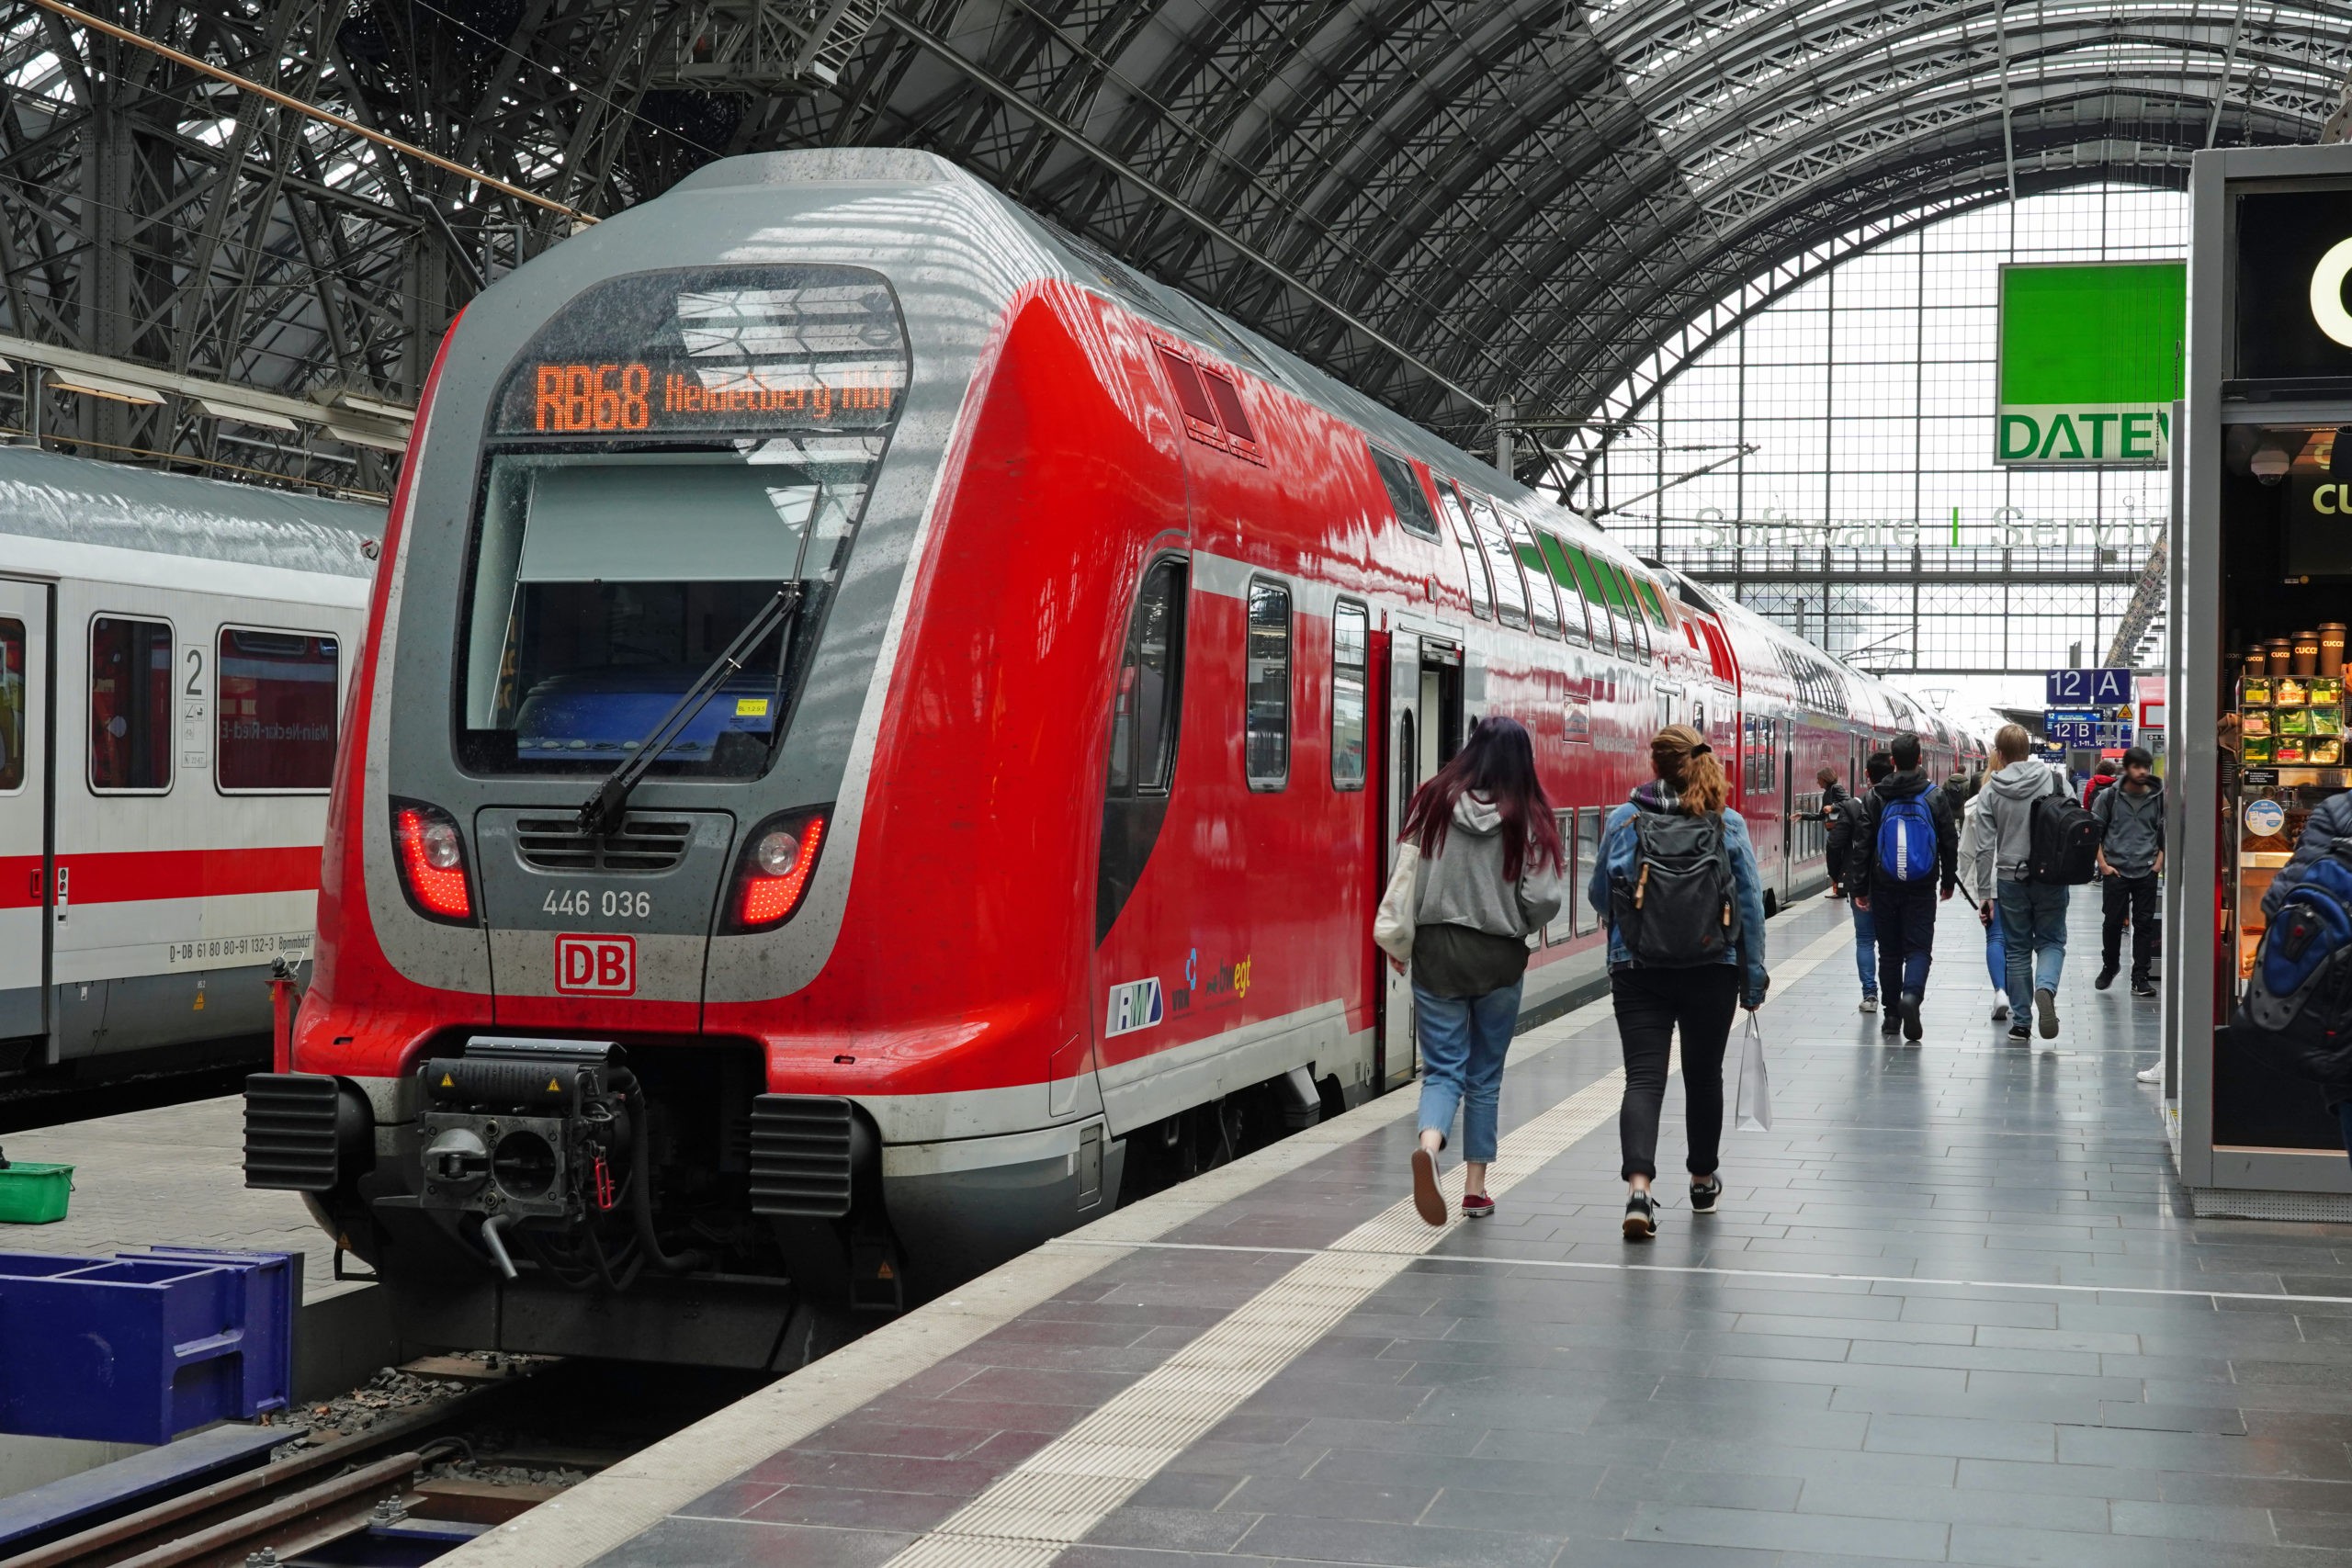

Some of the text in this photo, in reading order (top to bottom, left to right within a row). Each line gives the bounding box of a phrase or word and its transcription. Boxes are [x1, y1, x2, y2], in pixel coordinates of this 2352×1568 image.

[537, 365, 650, 430] RB68
[1694, 507, 1920, 550] Software
[186, 649, 203, 695] 2
[2050, 671, 2120, 696] 12 A
[2053, 723, 2071, 738] 12
[2078, 723, 2090, 738] B
[1897, 846, 1907, 874] PUMA
[542, 889, 650, 918] 446 036
[197, 942, 206, 958] 61
[209, 942, 220, 957] 80
[223, 939, 248, 955] 80-91
[251, 937, 274, 953] 132-3
[565, 943, 627, 987] DB
[1116, 980, 1158, 1031] RMV
